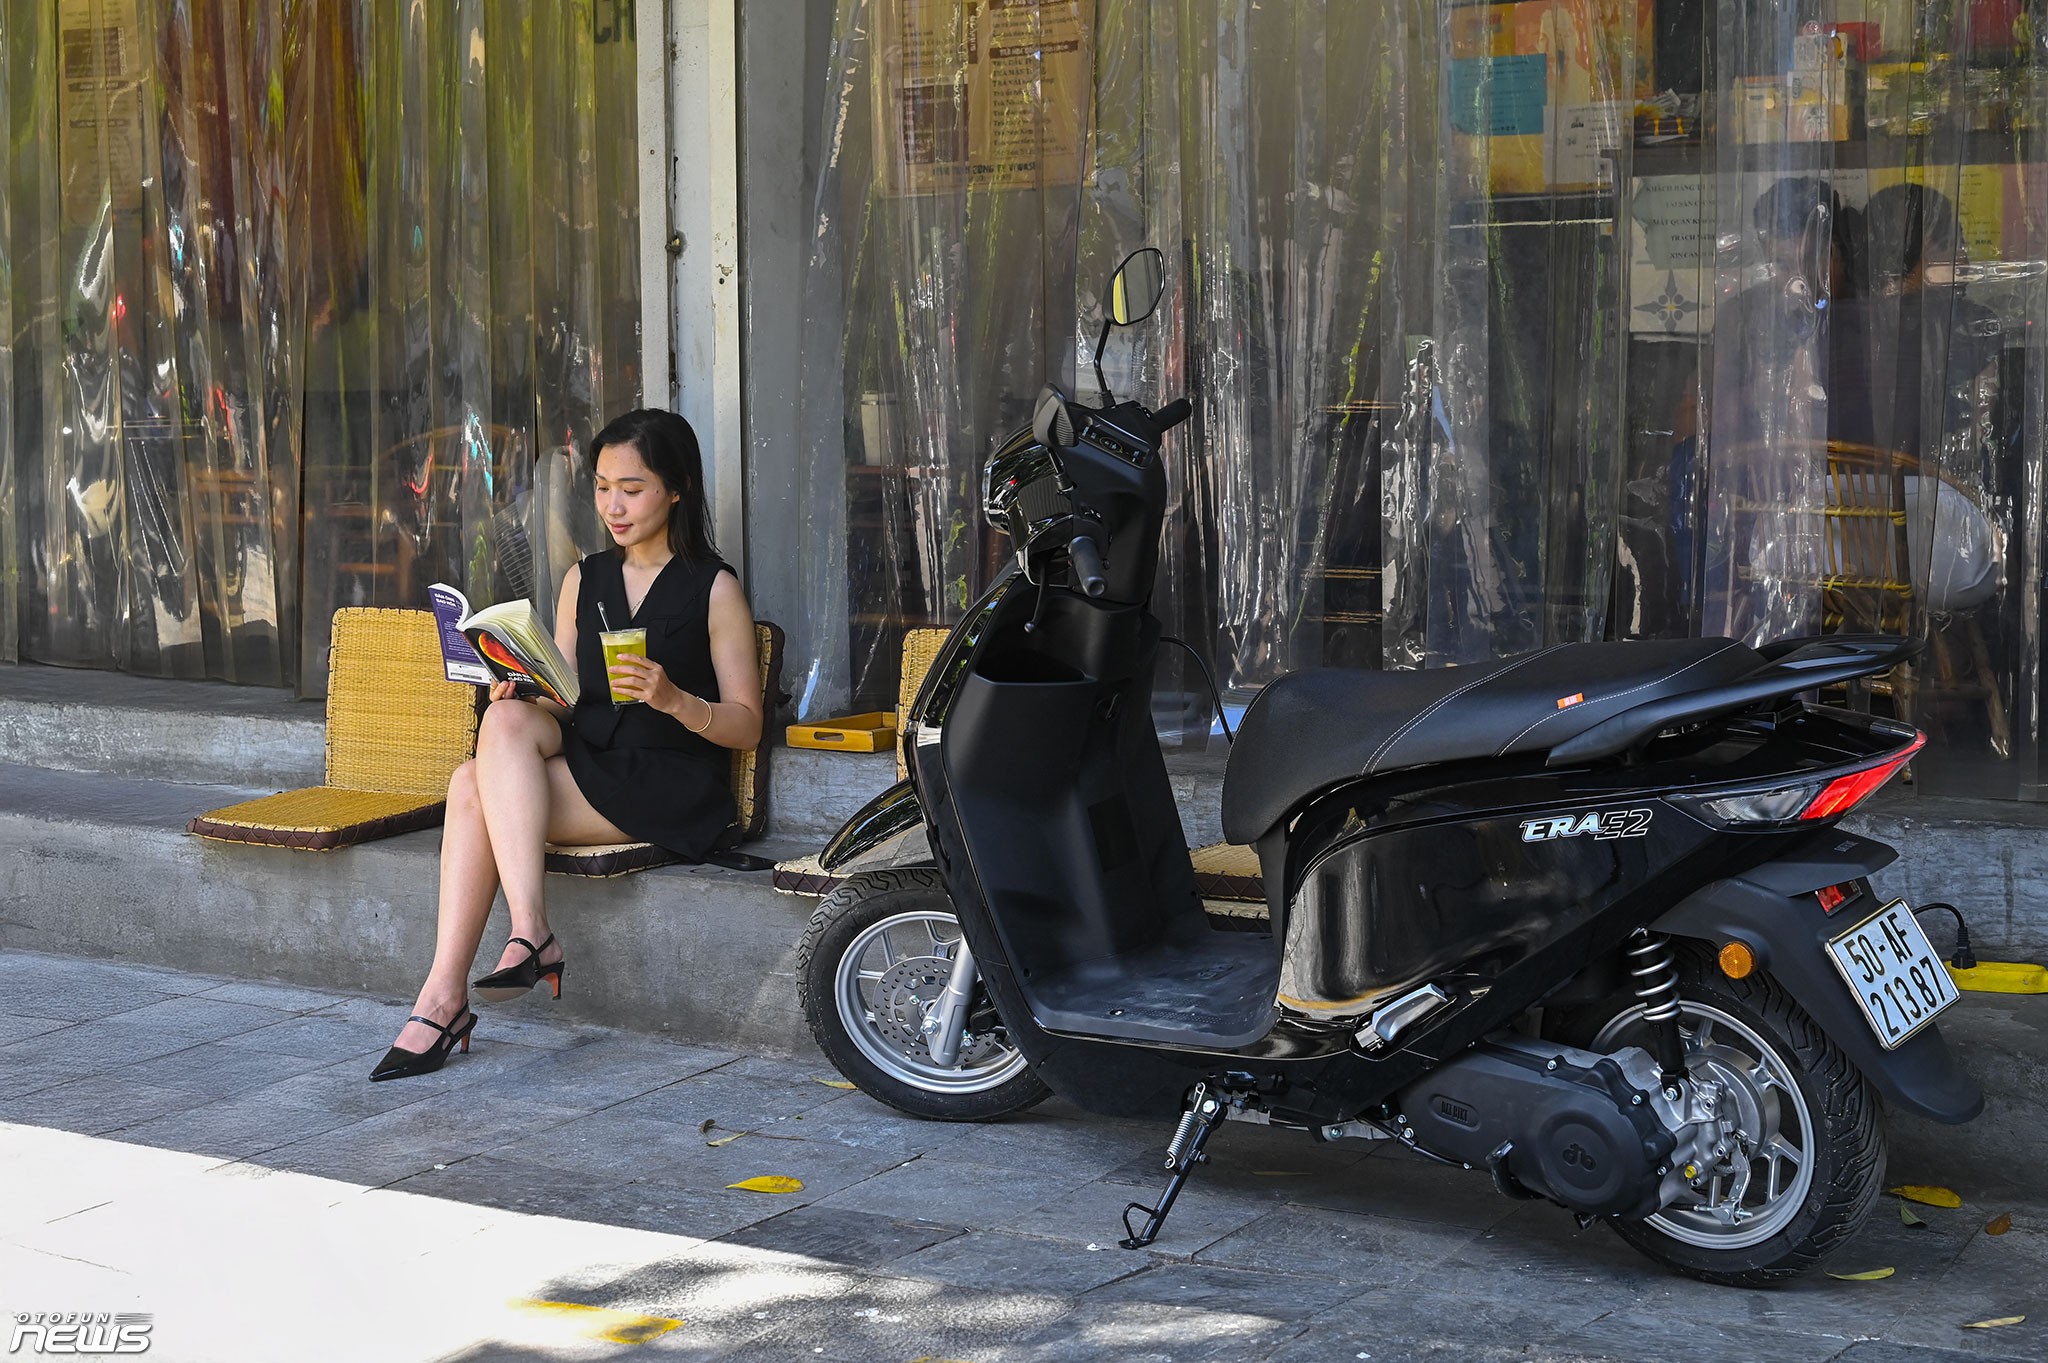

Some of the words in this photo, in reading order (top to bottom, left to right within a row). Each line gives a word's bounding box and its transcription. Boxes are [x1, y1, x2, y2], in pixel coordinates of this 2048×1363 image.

[1519, 812, 1607, 842] ERA
[1844, 912, 1913, 984] 50-AF
[1870, 955, 1946, 1038] 213.87
